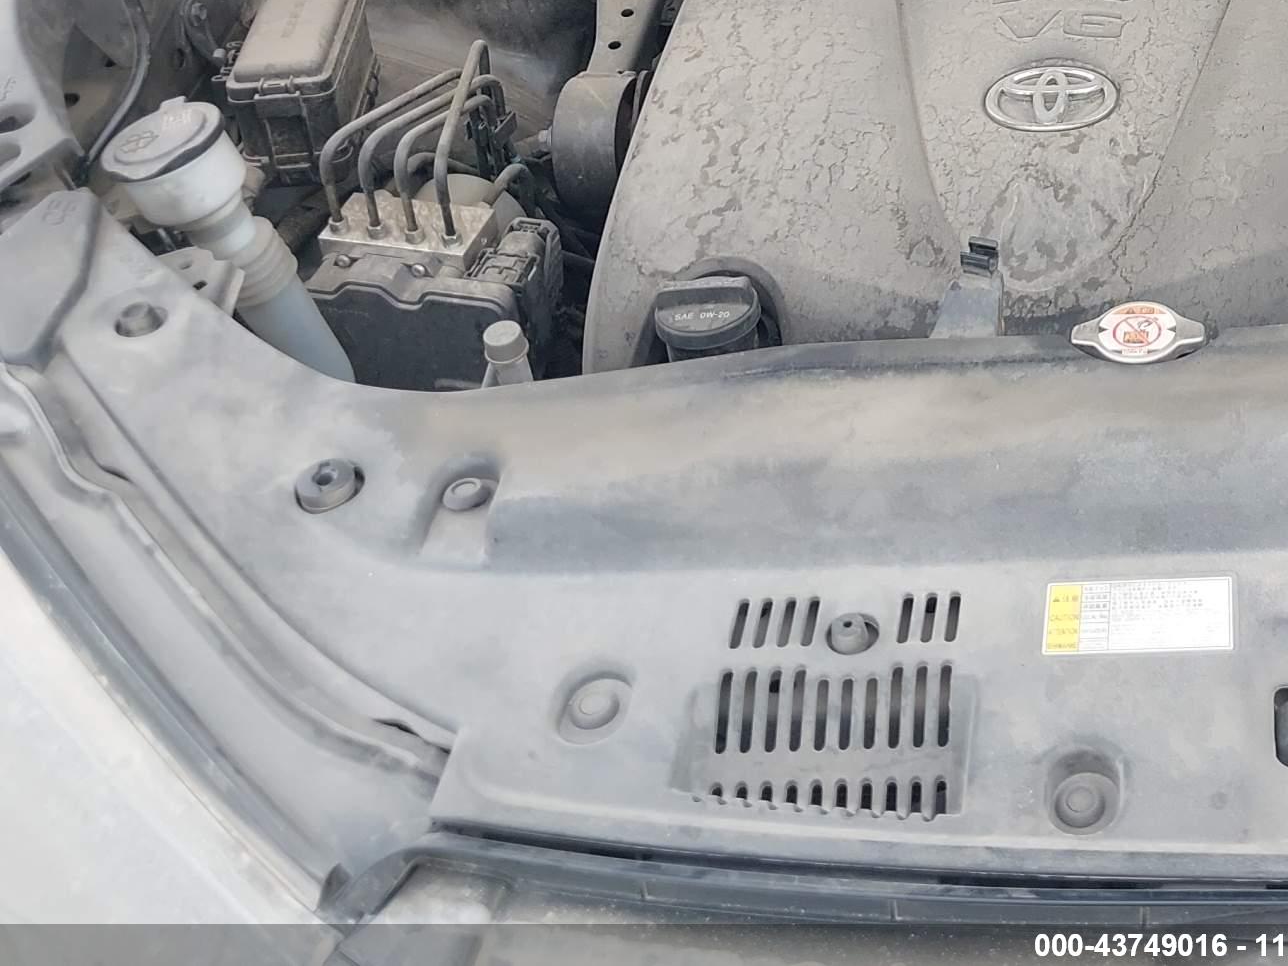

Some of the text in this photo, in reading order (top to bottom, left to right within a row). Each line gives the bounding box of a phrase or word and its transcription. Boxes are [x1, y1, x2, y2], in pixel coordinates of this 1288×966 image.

[996, 9, 1124, 39] V6
[674, 310, 730, 322] SAE 0W-20
